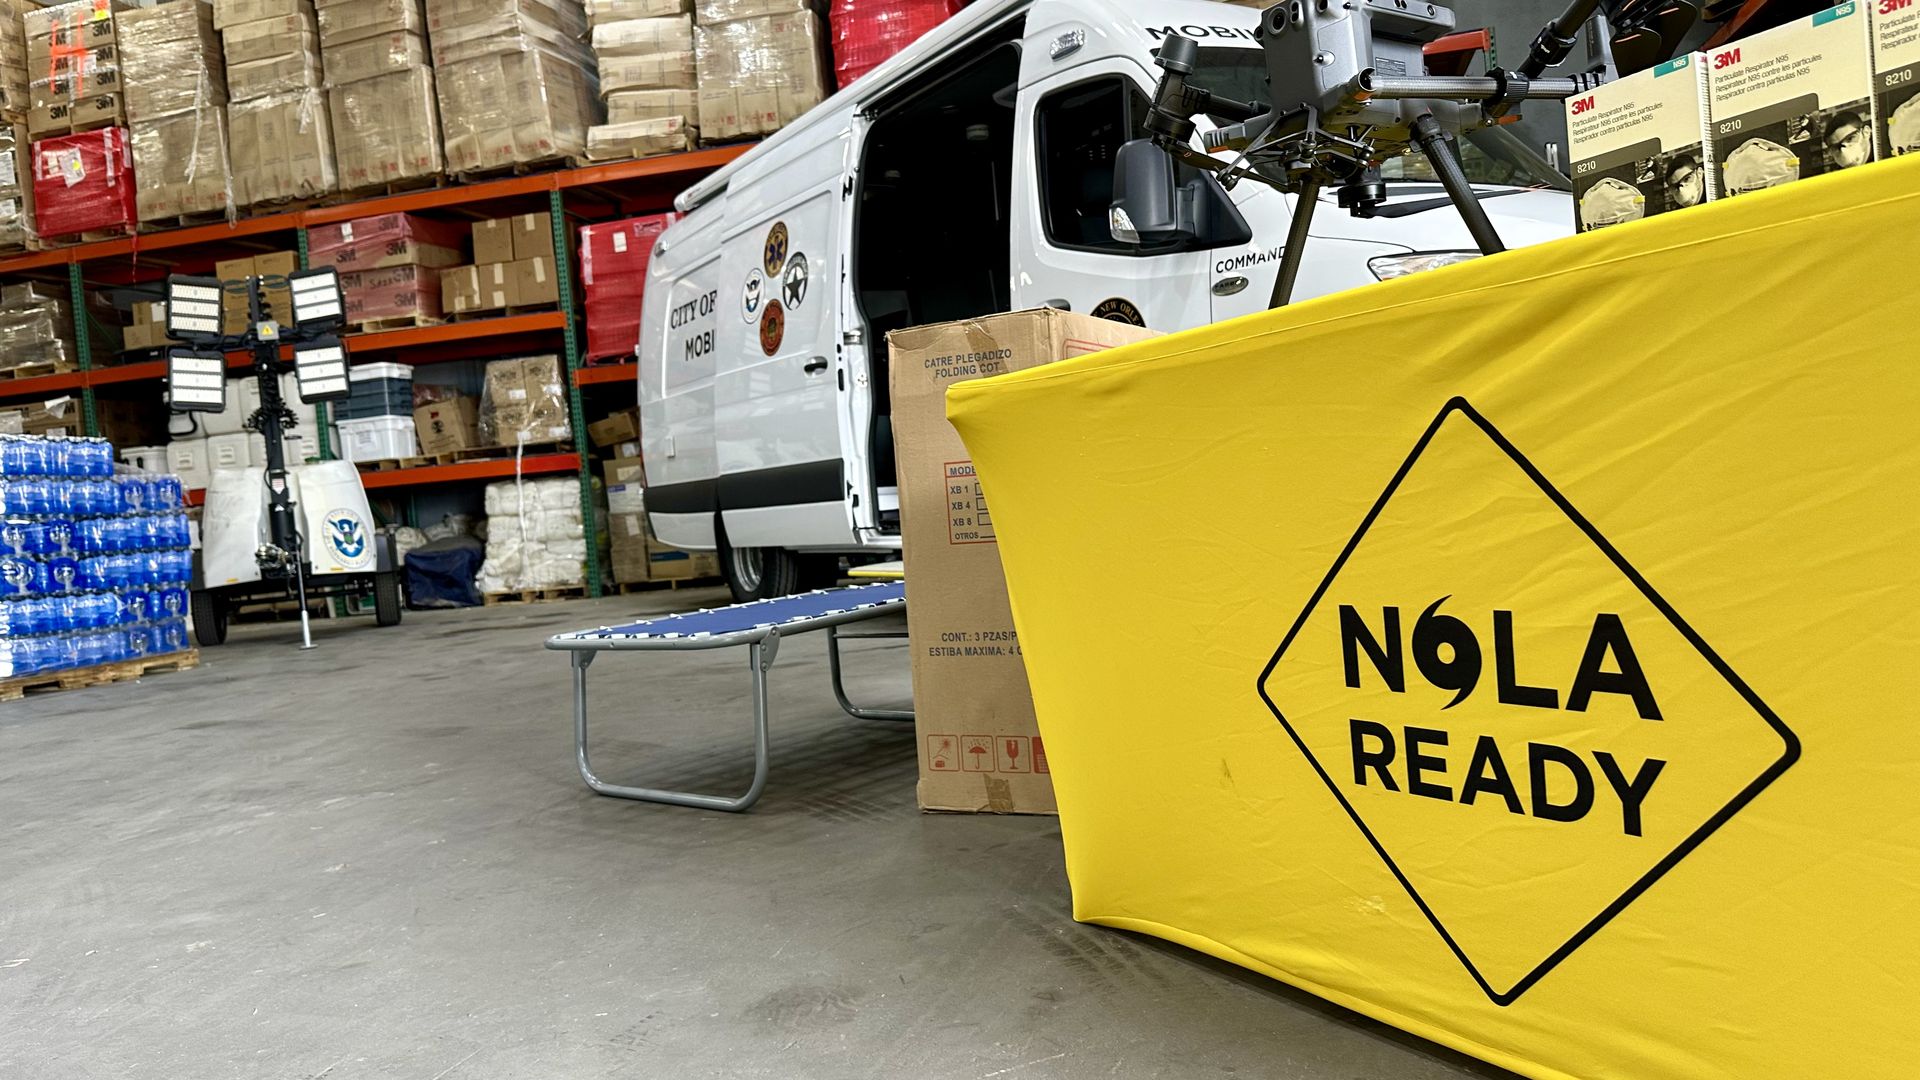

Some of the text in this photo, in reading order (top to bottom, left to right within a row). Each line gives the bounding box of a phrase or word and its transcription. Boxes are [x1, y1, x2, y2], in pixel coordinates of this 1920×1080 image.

[1836, 4, 1852, 16] N95
[92, 23, 112, 37] 3M
[1880, 14, 1916, 30] Particulate
[1880, 23, 1918, 40] Respirateur
[1880, 34, 1918, 50] Respirador
[96, 46, 113, 61] 3M
[1714, 48, 1741, 70] 3M
[1715, 54, 1789, 84] Particulate Respirator N95
[1715, 54, 1822, 93] Respirateur N95 contre les particules
[96, 70, 116, 86] 3M
[1716, 66, 1810, 102] Respirador contra particulas N95
[1885, 70, 1912, 86] 8210
[96, 96, 114, 110] 3M
[1571, 96, 1595, 116] 3M
[50, 105, 68, 120] 3M
[1572, 102, 1635, 128] Particulate Respirator N95
[1573, 122, 1600, 136] Respirateur
[1600, 118, 1612, 127] N95
[1612, 114, 1628, 124] contre
[1637, 102, 1664, 116] particules
[1574, 114, 1654, 144] Respirador contra particulas N95
[1719, 119, 1742, 134] 8210
[1577, 160, 1596, 174] 8210
[336, 248, 356, 264] 3M
[386, 240, 408, 256] 3M
[342, 274, 362, 289] 3M
[394, 292, 416, 308] 3M
[671, 289, 718, 330] CITY OF
[1100, 301, 1117, 316] NEW
[685, 329, 715, 361] MOBI
[924, 348, 1012, 368] CATRE PLEGADIZO
[936, 362, 1000, 378] FOLDING COT
[950, 486, 962, 494] XB
[952, 502, 963, 510] XB
[953, 517, 972, 526] XB 8
[954, 532, 979, 540] OTROS
[941, 632, 972, 642] CONT.:
[974, 632, 980, 642] 3
[928, 646, 962, 657] ESTIBA
[964, 646, 1006, 656] MAXIMA:
[1008, 646, 1014, 656] 4
[1339, 594, 1664, 721] NOLA
[1349, 719, 1667, 838] READY
